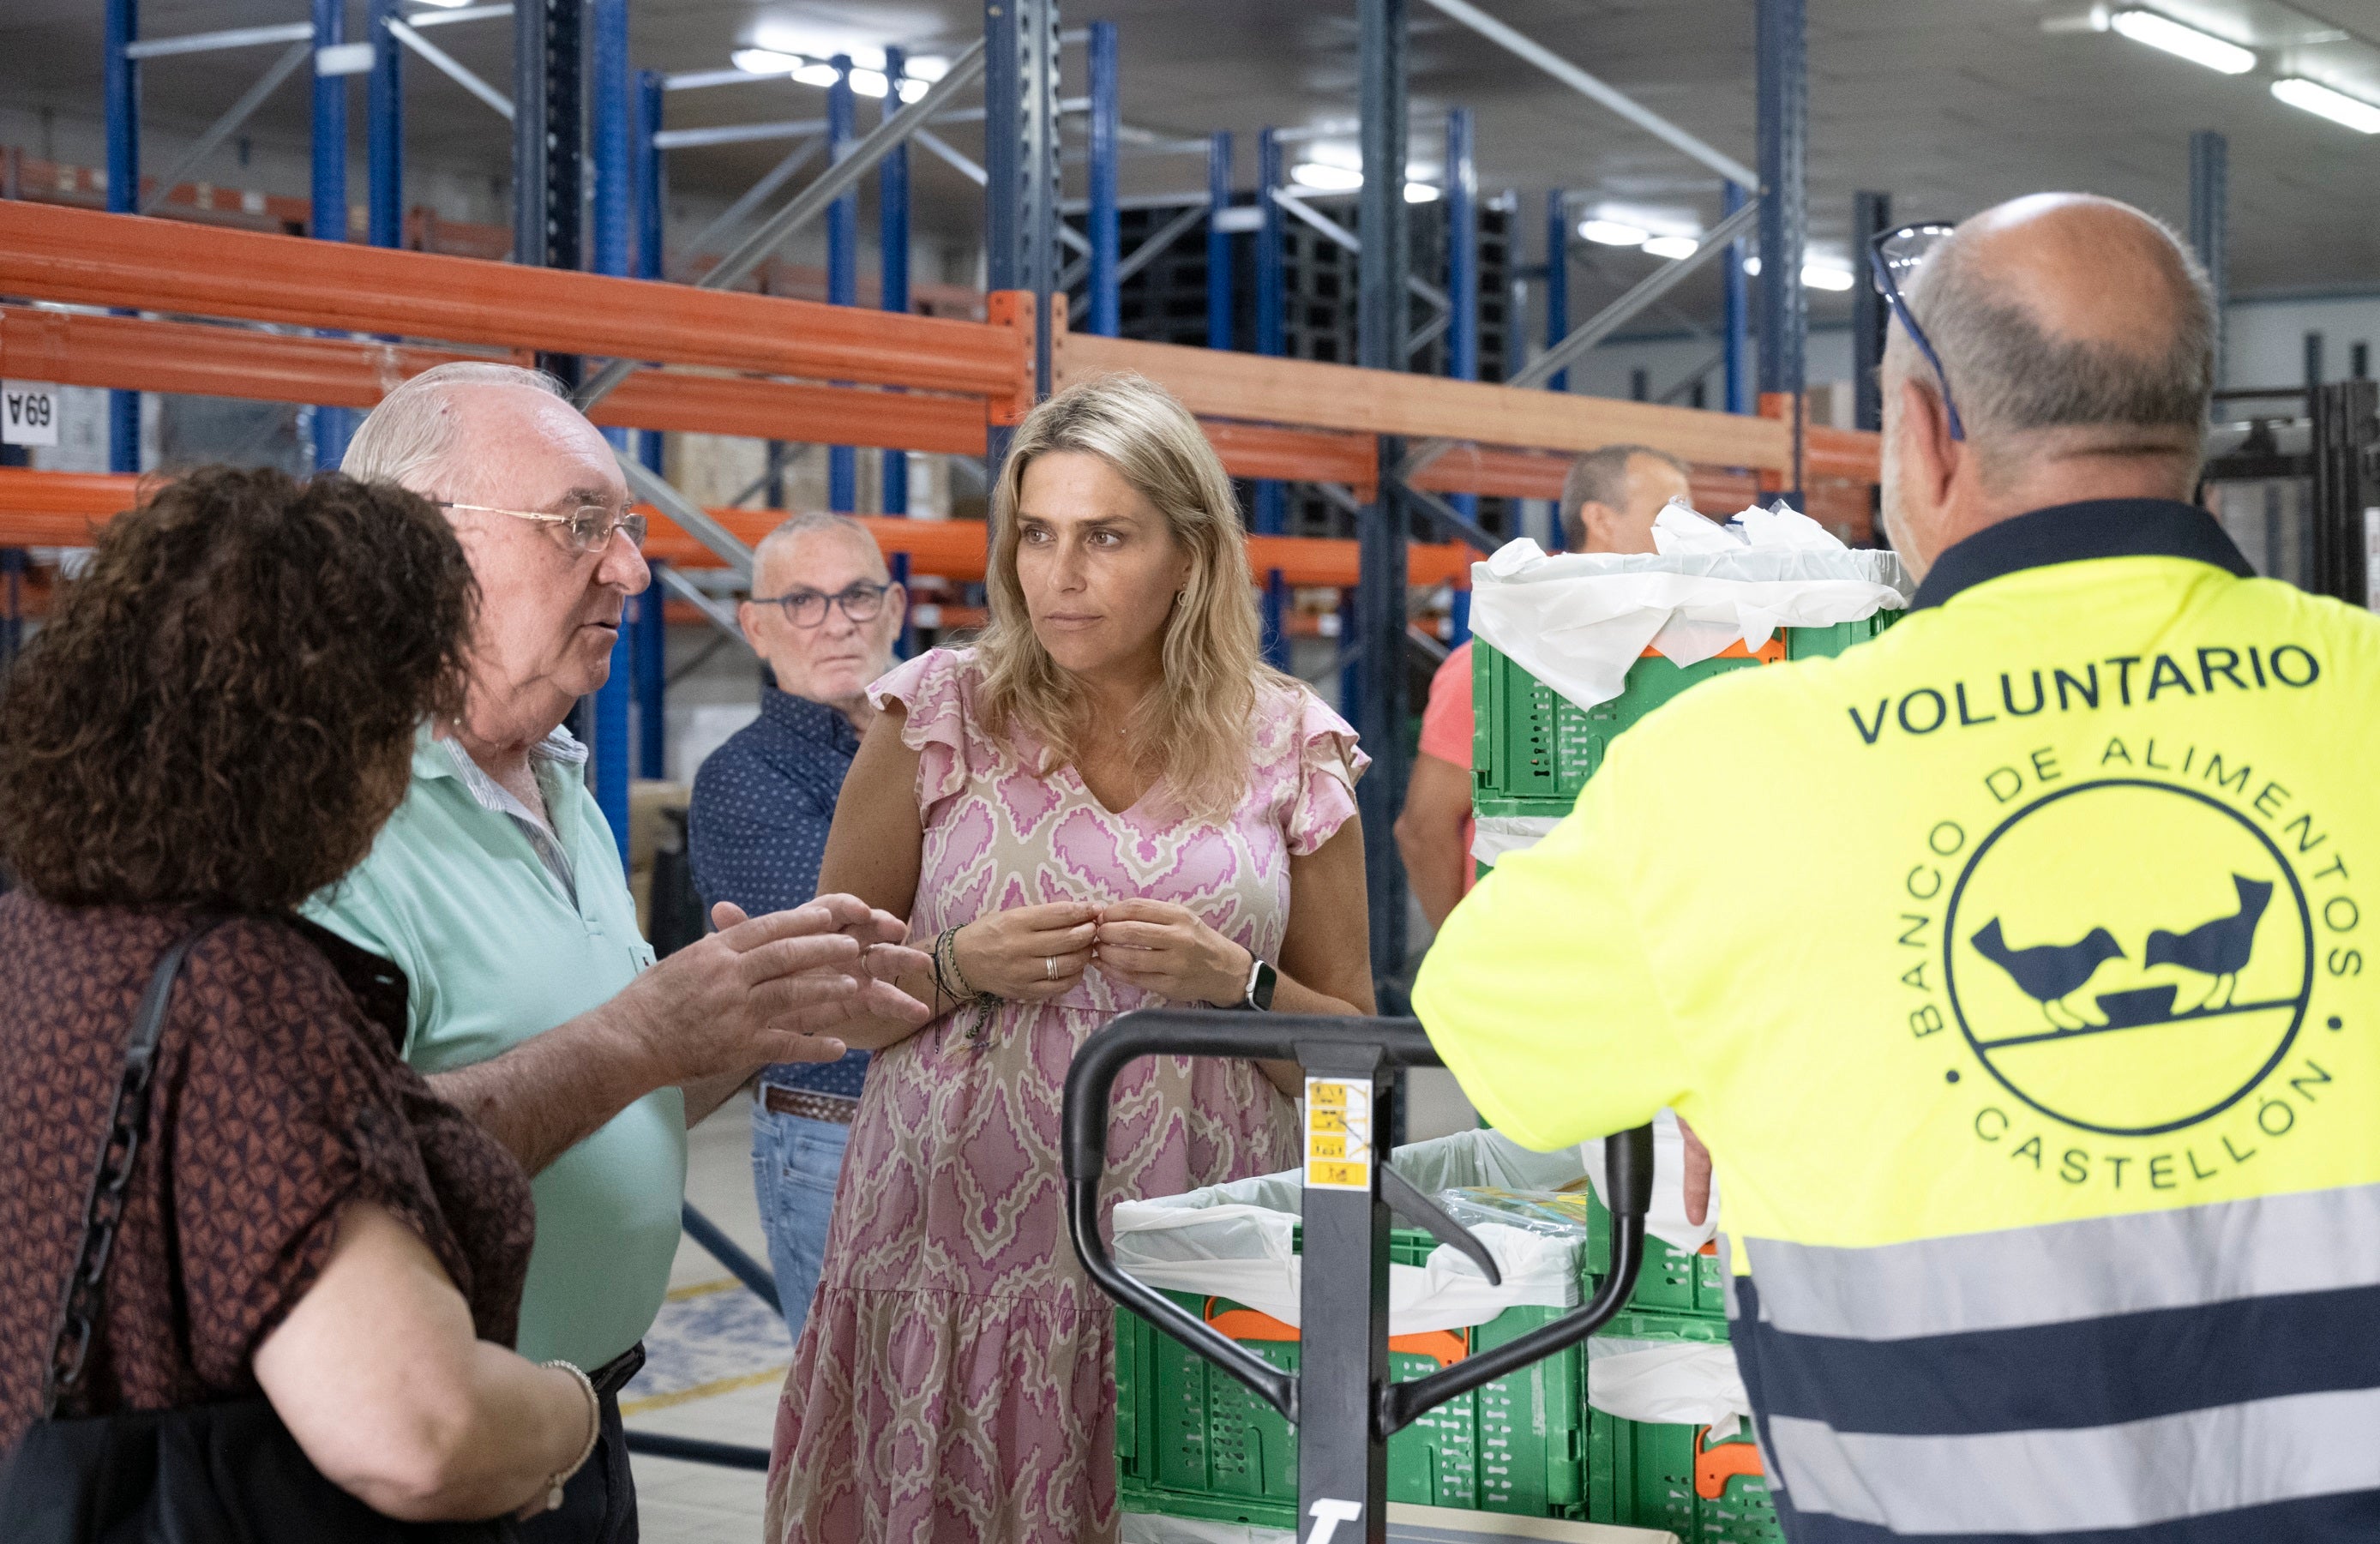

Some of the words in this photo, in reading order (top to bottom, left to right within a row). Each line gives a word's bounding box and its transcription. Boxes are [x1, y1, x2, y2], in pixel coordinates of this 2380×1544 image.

[7, 394, 51, 426] 69A
[1847, 643, 2322, 747] VOLUNTARIO
[1897, 820, 1966, 1038] BANCO
[1984, 746, 2063, 804] DE
[2101, 736, 2363, 979] ALIMENTOS
[1974, 1060, 2333, 1191] CASTELLÓN
